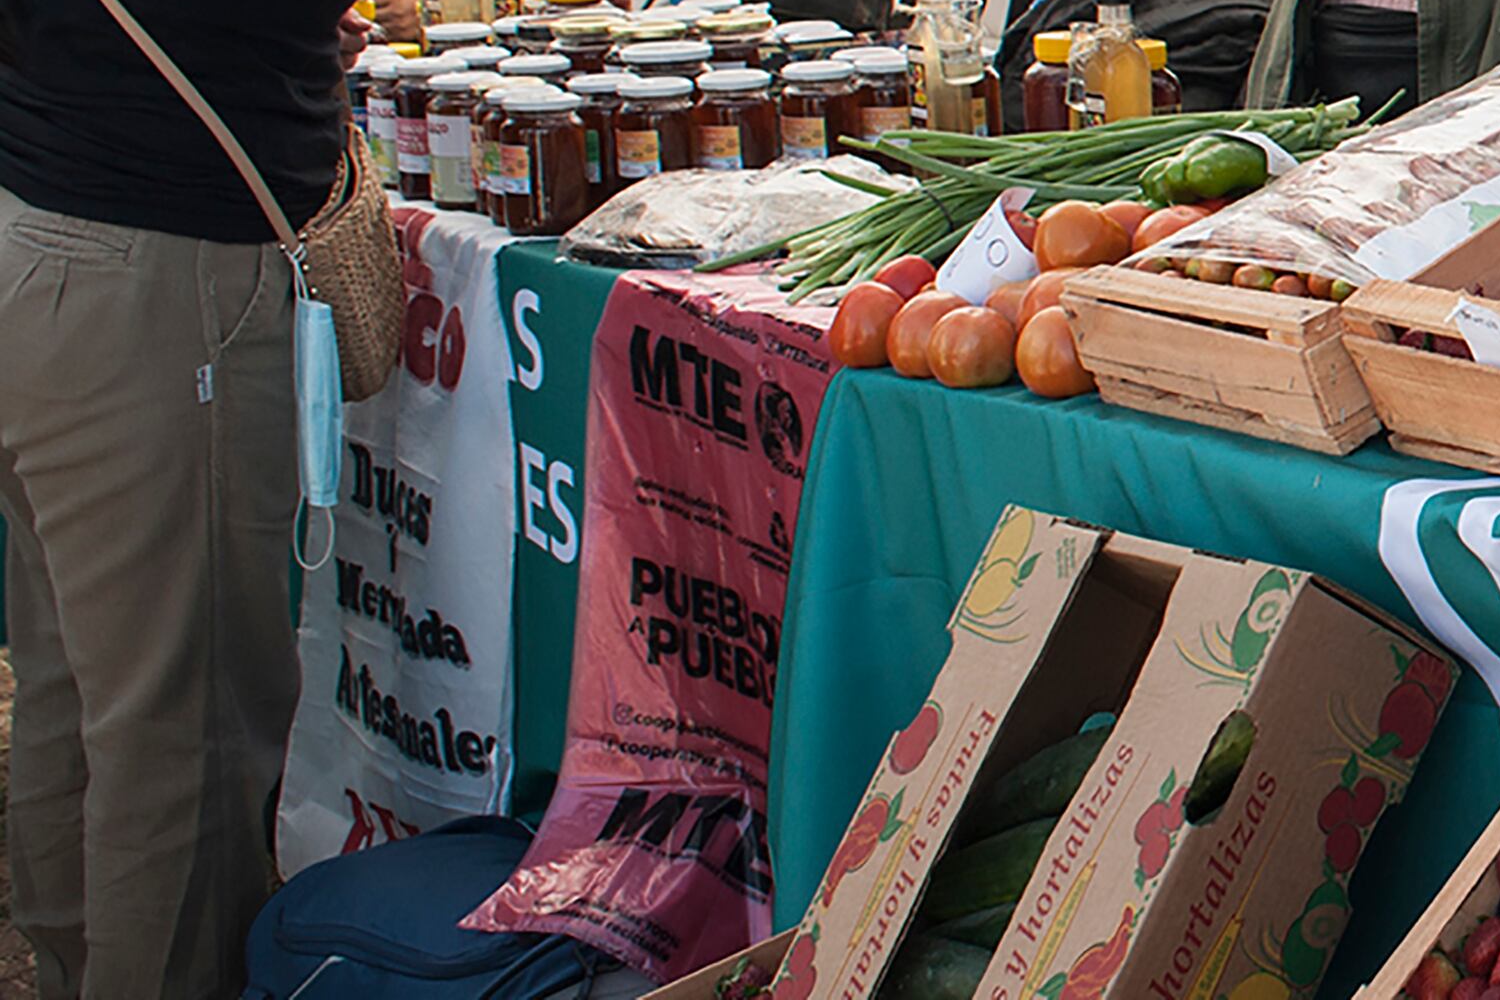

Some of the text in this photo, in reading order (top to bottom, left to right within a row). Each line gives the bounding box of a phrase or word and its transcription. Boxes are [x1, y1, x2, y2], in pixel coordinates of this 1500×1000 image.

[629, 323, 748, 441] MTE
[628, 615, 645, 635] A
[926, 709, 997, 828] Frutas
[908, 833, 928, 863] y
[1004, 743, 1134, 981] y hortalizas
[1148, 770, 1278, 1000] hortalizas
